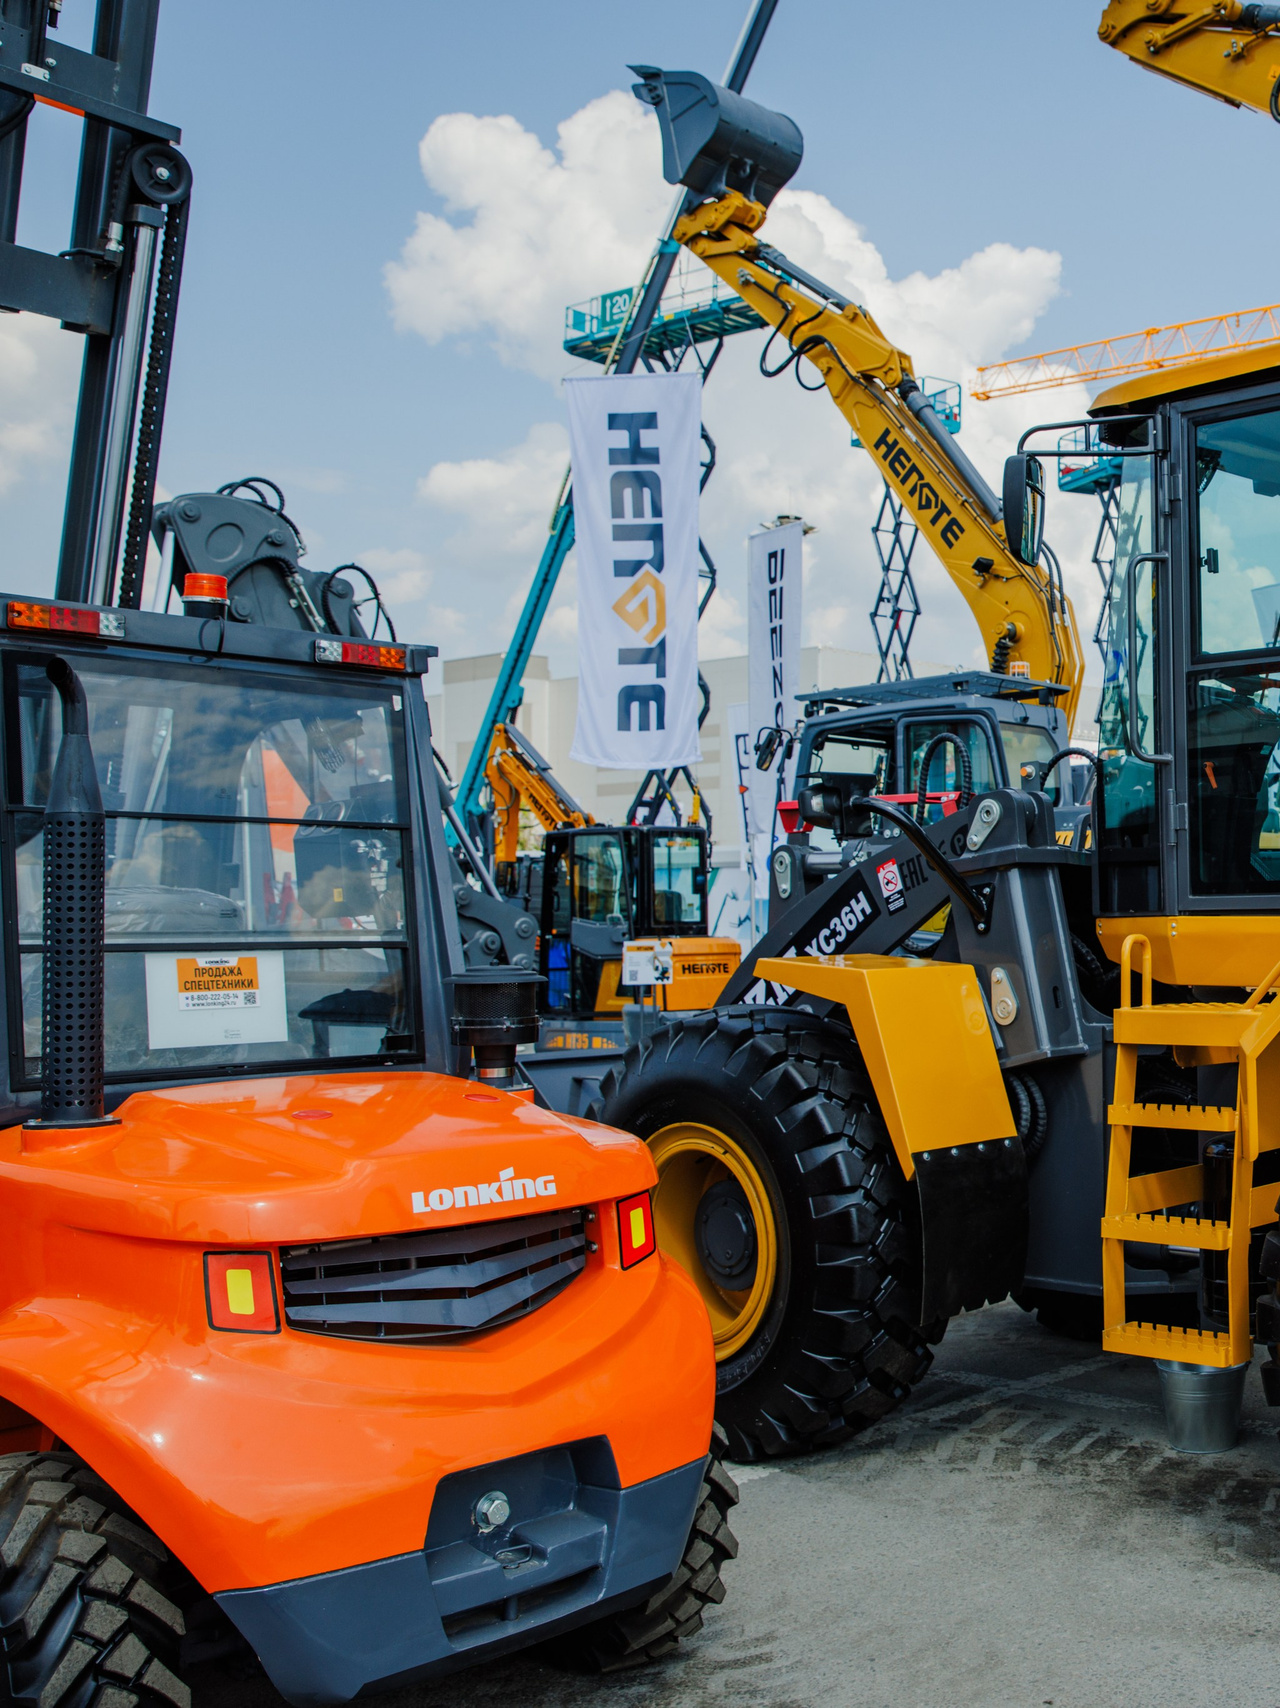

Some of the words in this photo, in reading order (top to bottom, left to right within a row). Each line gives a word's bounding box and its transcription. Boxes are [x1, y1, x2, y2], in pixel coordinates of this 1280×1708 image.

[612, 294, 630, 314] 20
[873, 427, 965, 549] HENGTE
[607, 412, 666, 731] HENGTE
[194, 967, 243, 978] ПРОДАЖА
[184, 979, 254, 991] СПЕЦТЕХНИКИ
[190, 993, 239, 1001] 8-800-222-05-14
[411, 1166, 557, 1213] LONKING
